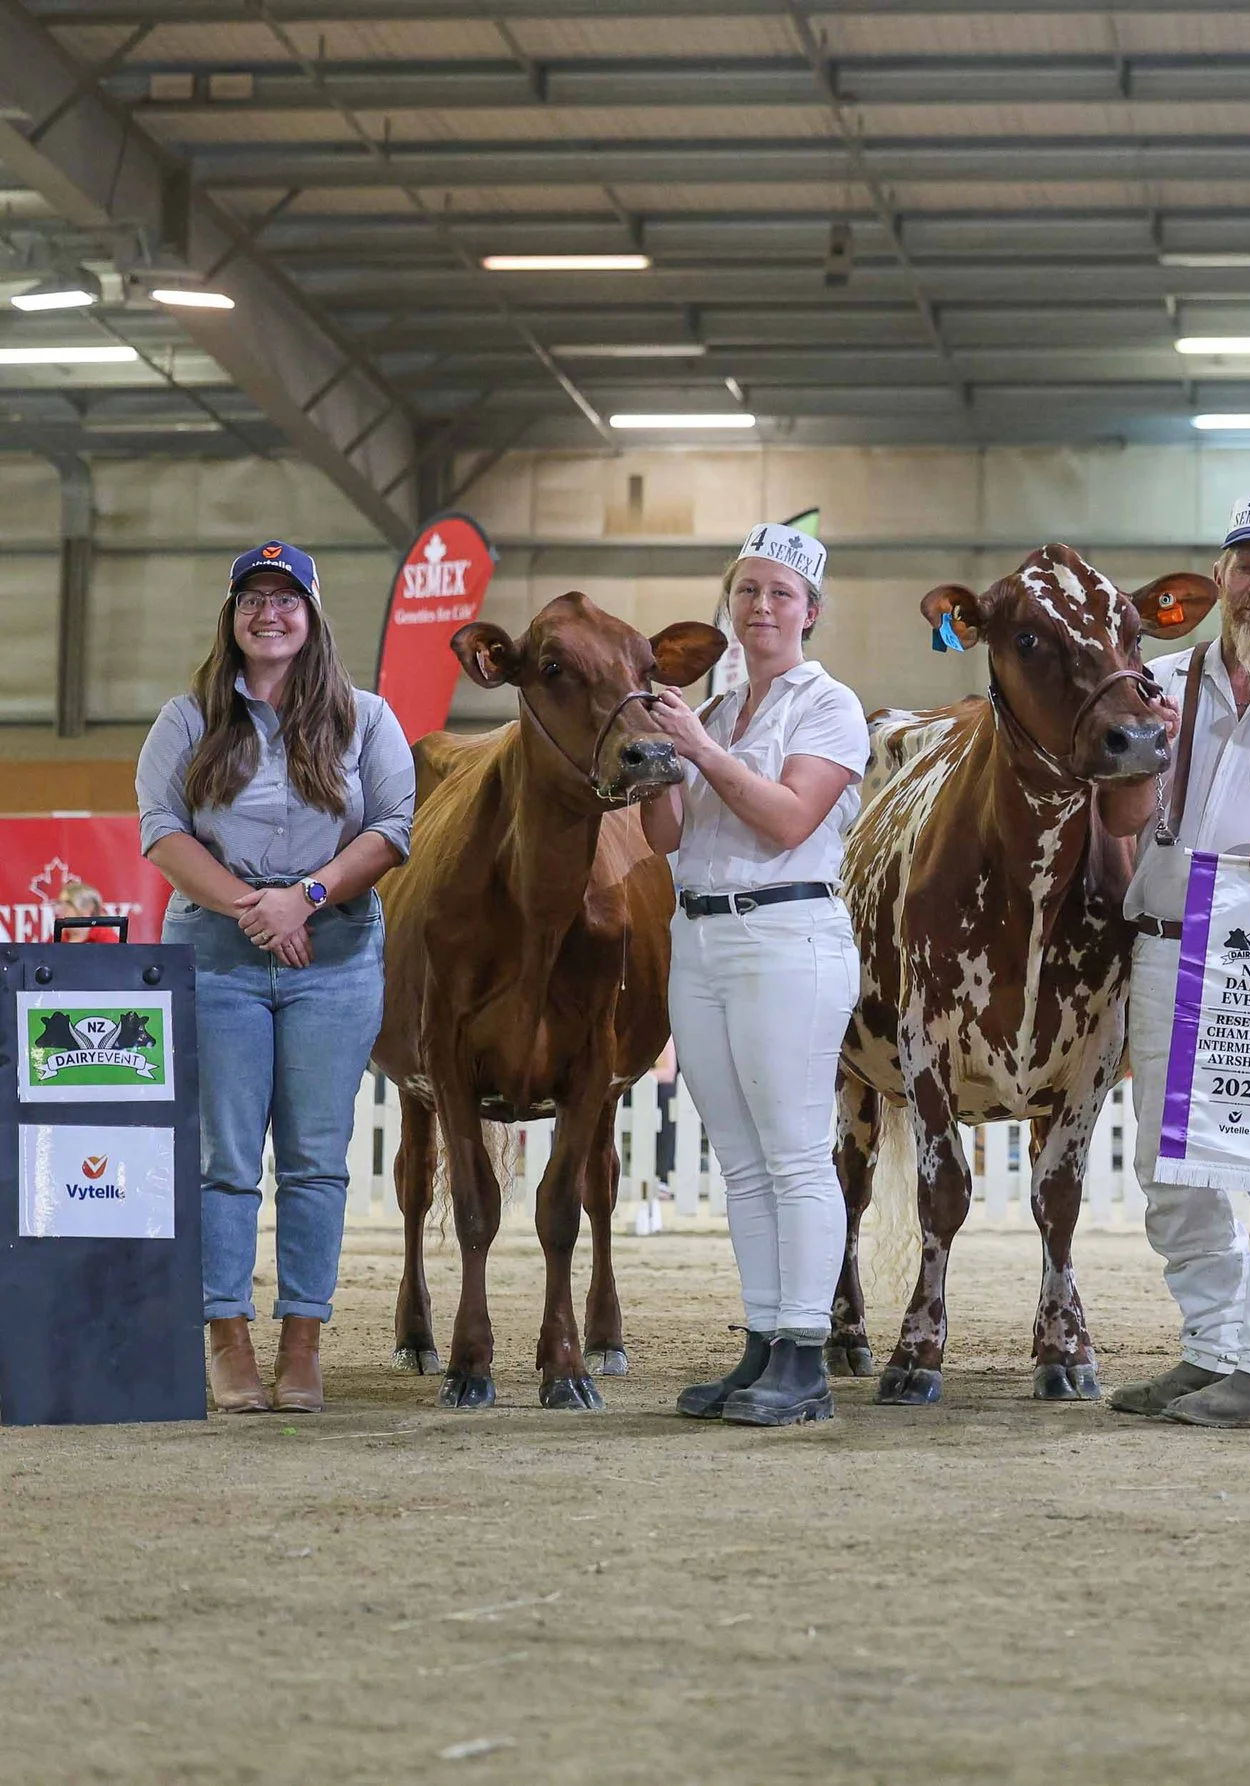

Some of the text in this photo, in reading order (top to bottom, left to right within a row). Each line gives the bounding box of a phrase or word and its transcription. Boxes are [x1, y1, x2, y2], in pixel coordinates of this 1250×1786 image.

[767, 541, 813, 575] SEMEX
[403, 560, 467, 599] SEMEX
[87, 1021, 106, 1033] NZ
[55, 1051, 140, 1067] DAIRYEVENT
[1219, 1124, 1250, 1135] Vytelle
